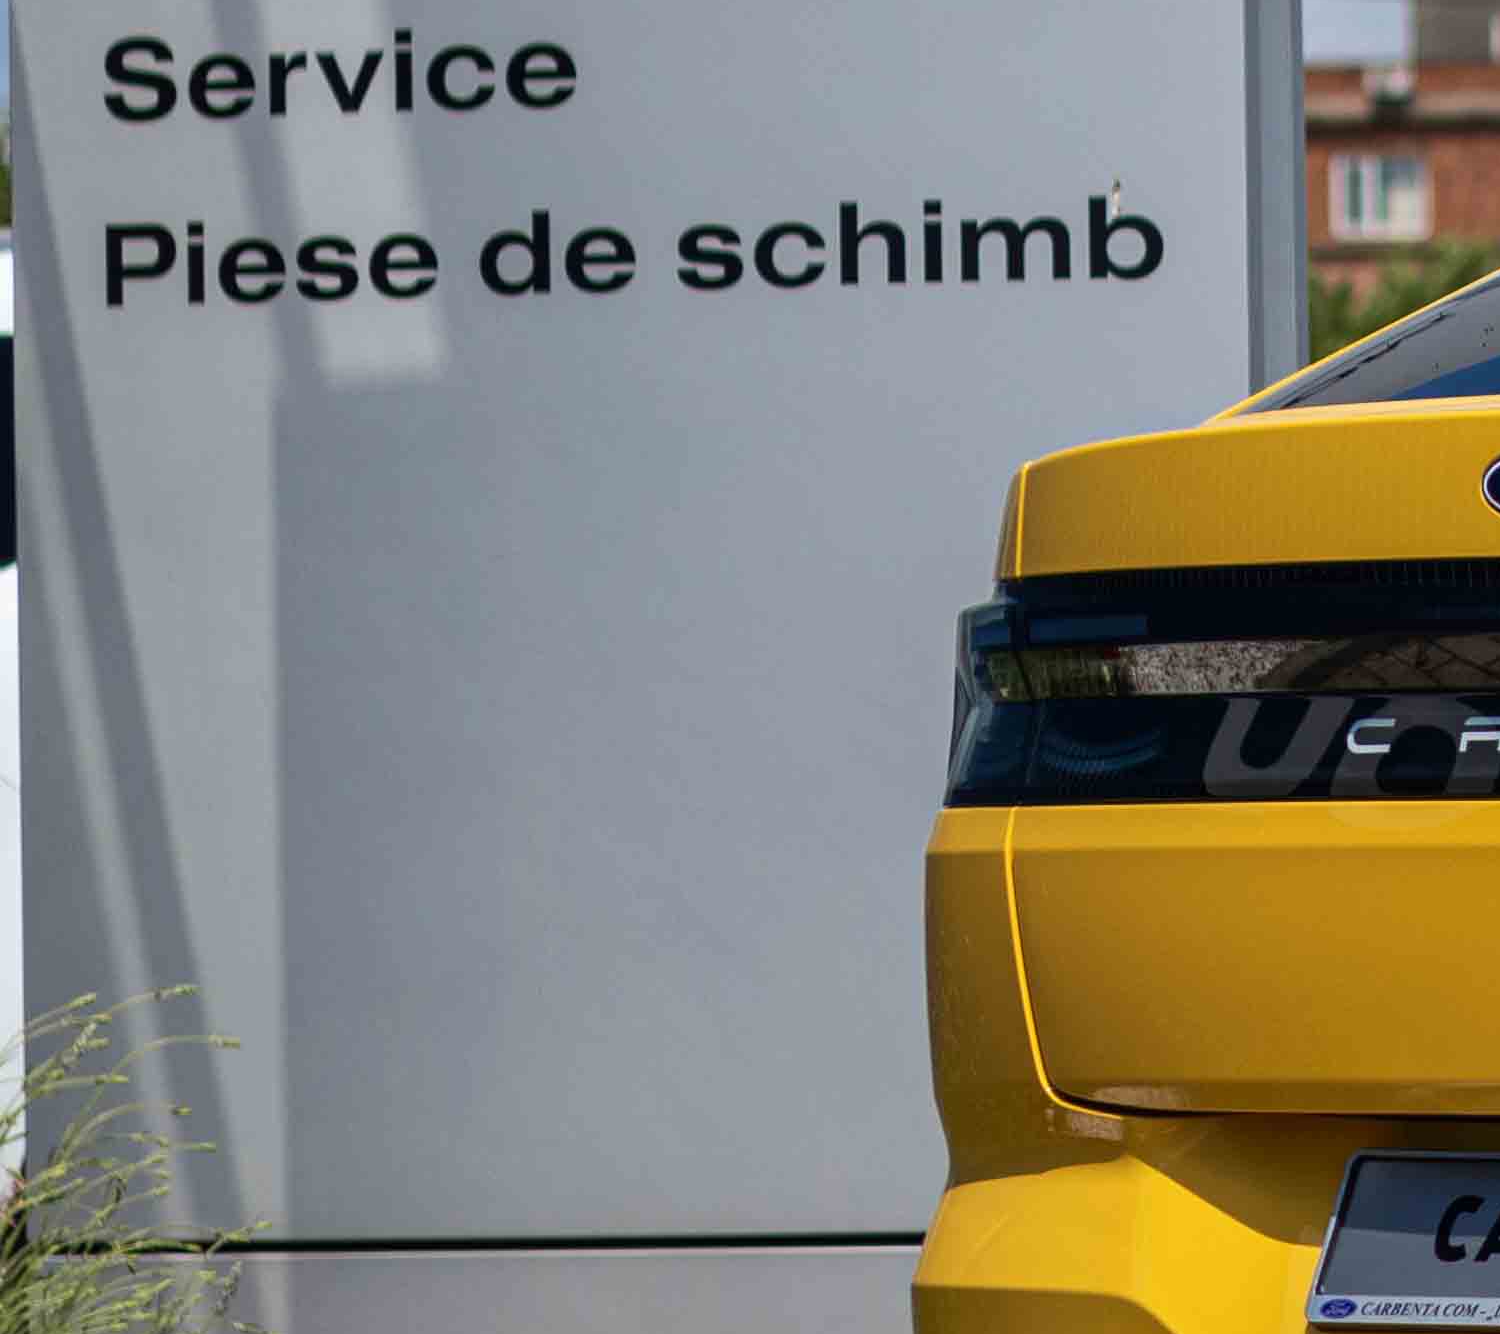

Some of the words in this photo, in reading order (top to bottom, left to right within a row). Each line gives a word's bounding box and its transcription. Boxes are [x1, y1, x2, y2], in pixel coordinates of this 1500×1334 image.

[103, 28, 578, 123] Service
[104, 221, 439, 307] Piese
[478, 209, 637, 296] de
[677, 196, 1165, 290] schimb
[1361, 1302, 1440, 1317] CARBENTA
[1443, 1303, 1479, 1317] COM
